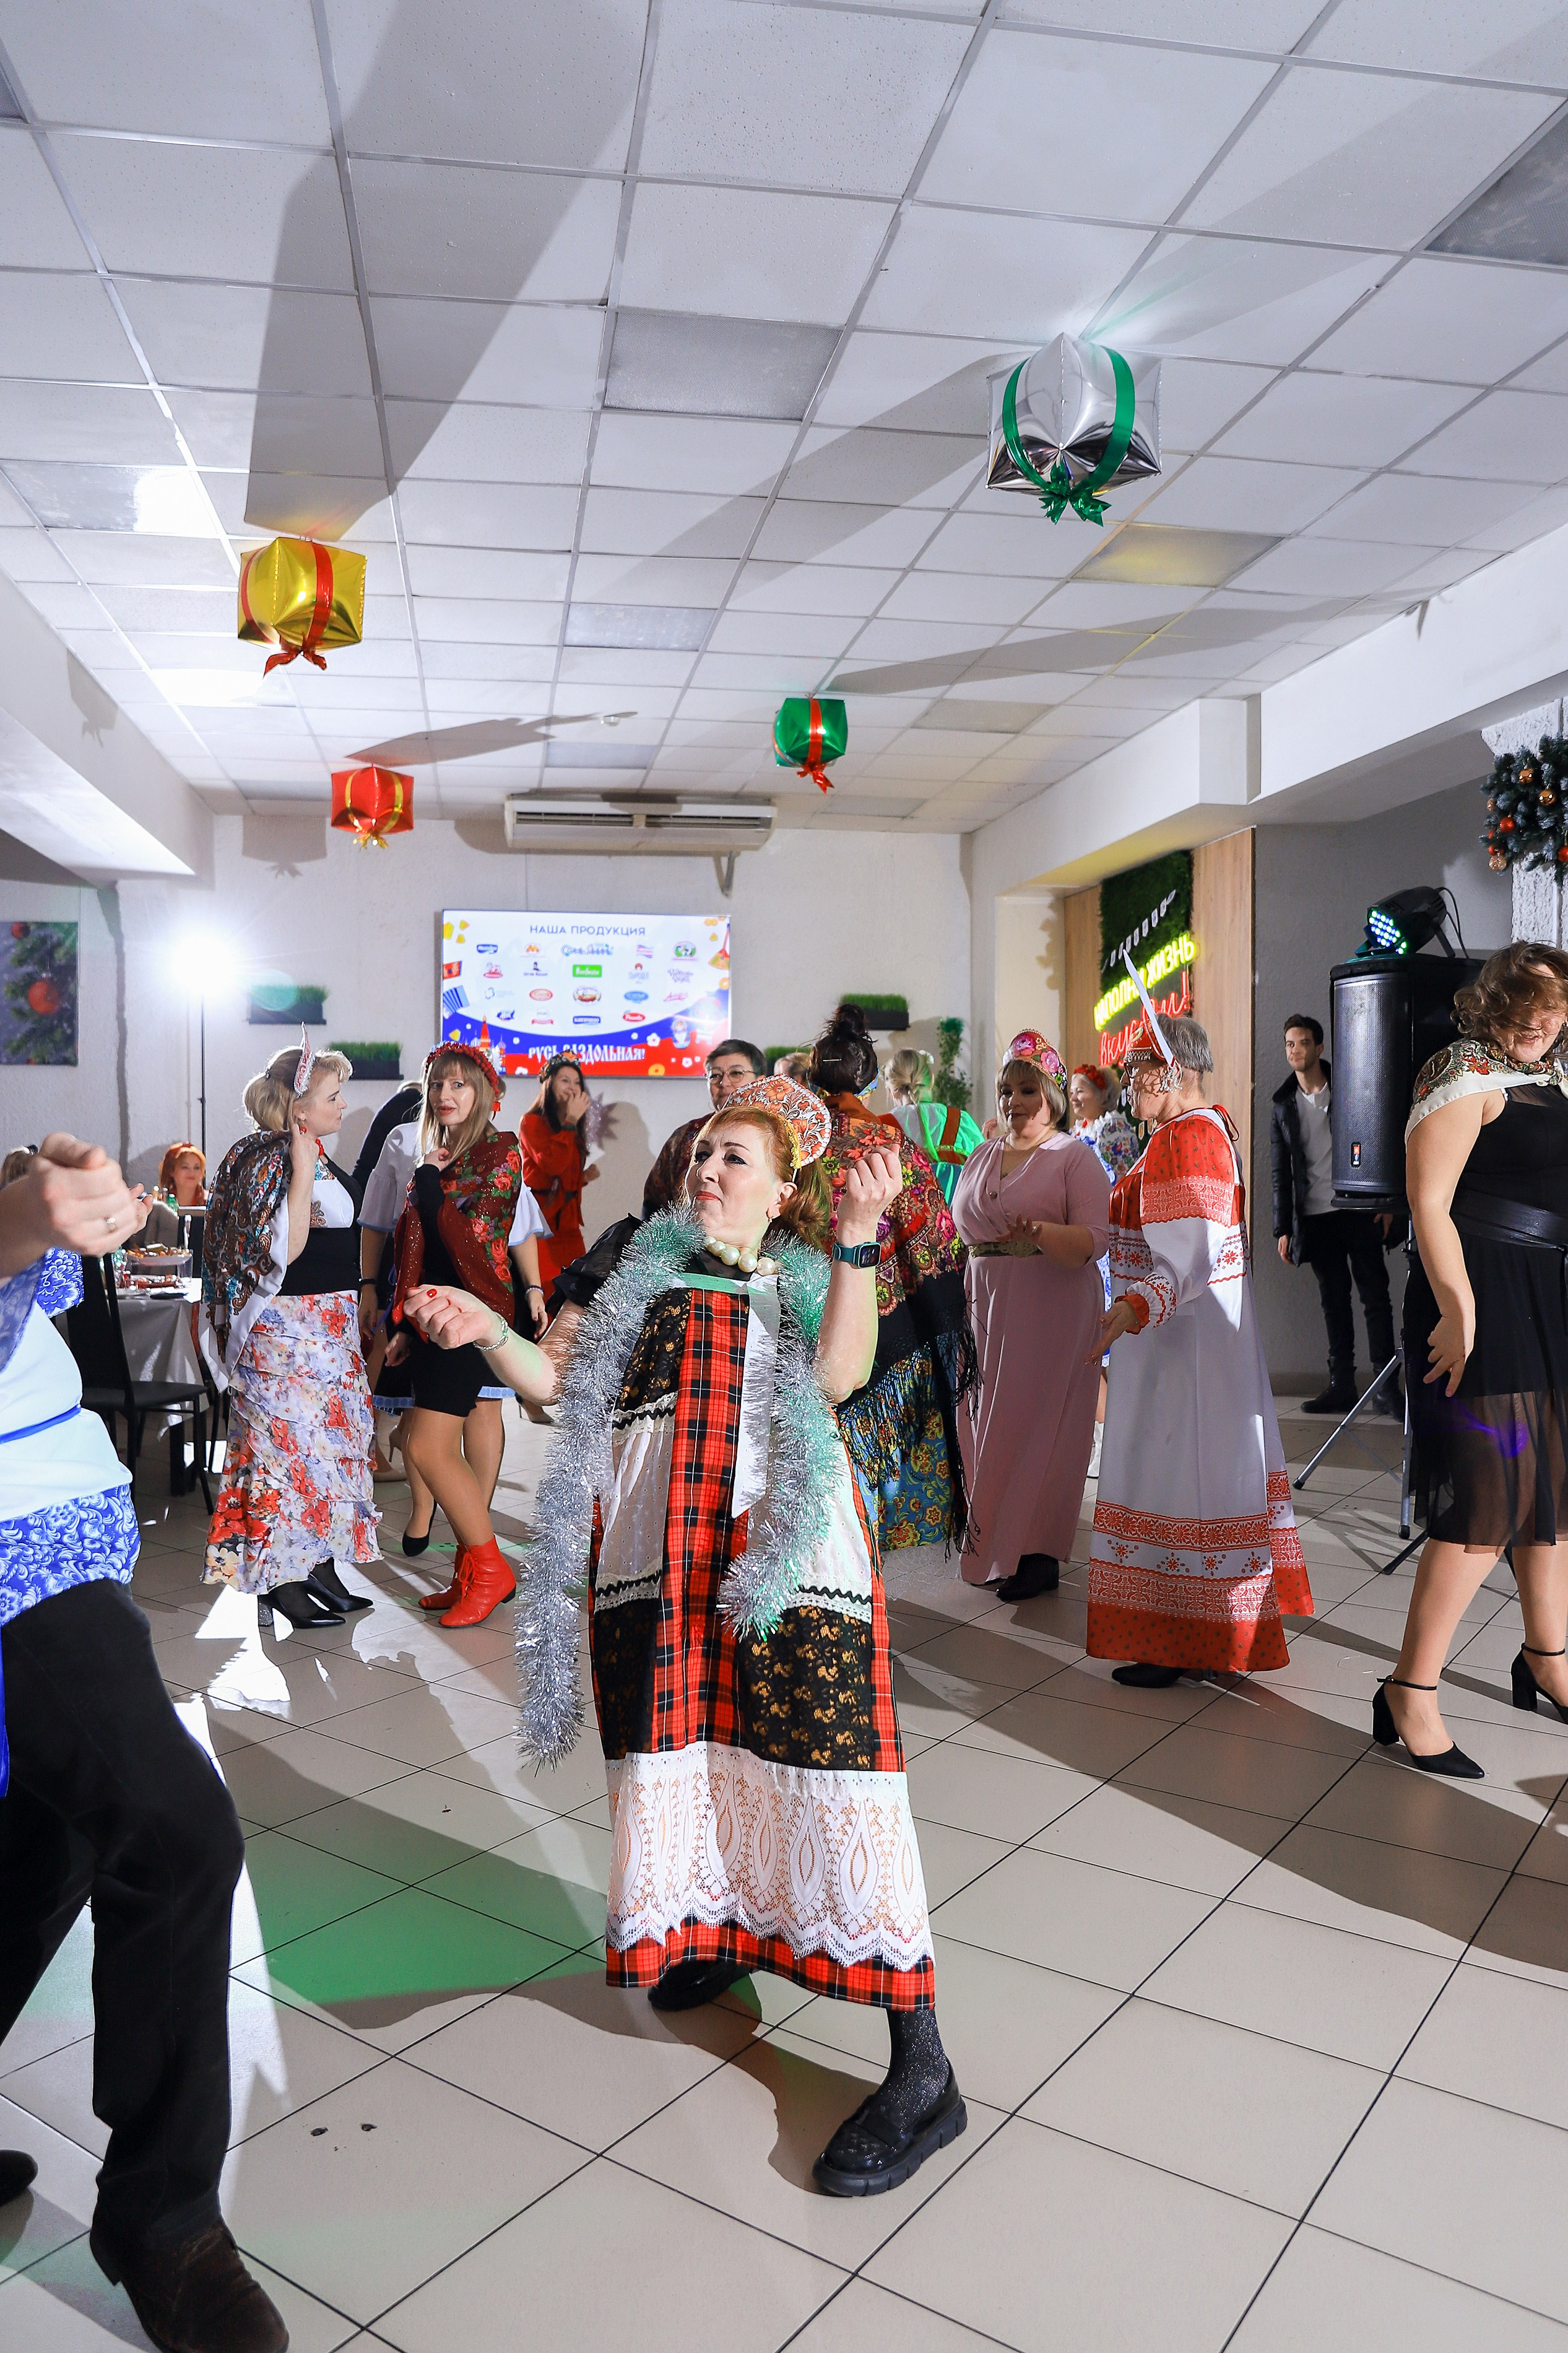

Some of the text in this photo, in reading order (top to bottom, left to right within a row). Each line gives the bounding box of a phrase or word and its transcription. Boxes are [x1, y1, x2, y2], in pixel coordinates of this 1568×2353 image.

[530, 924, 646, 936] НАША ПРОДУКЦИЯ
[1146, 934, 1195, 989] ЖИЗНЬ
[527, 1045, 557, 1063] РУСЬ
